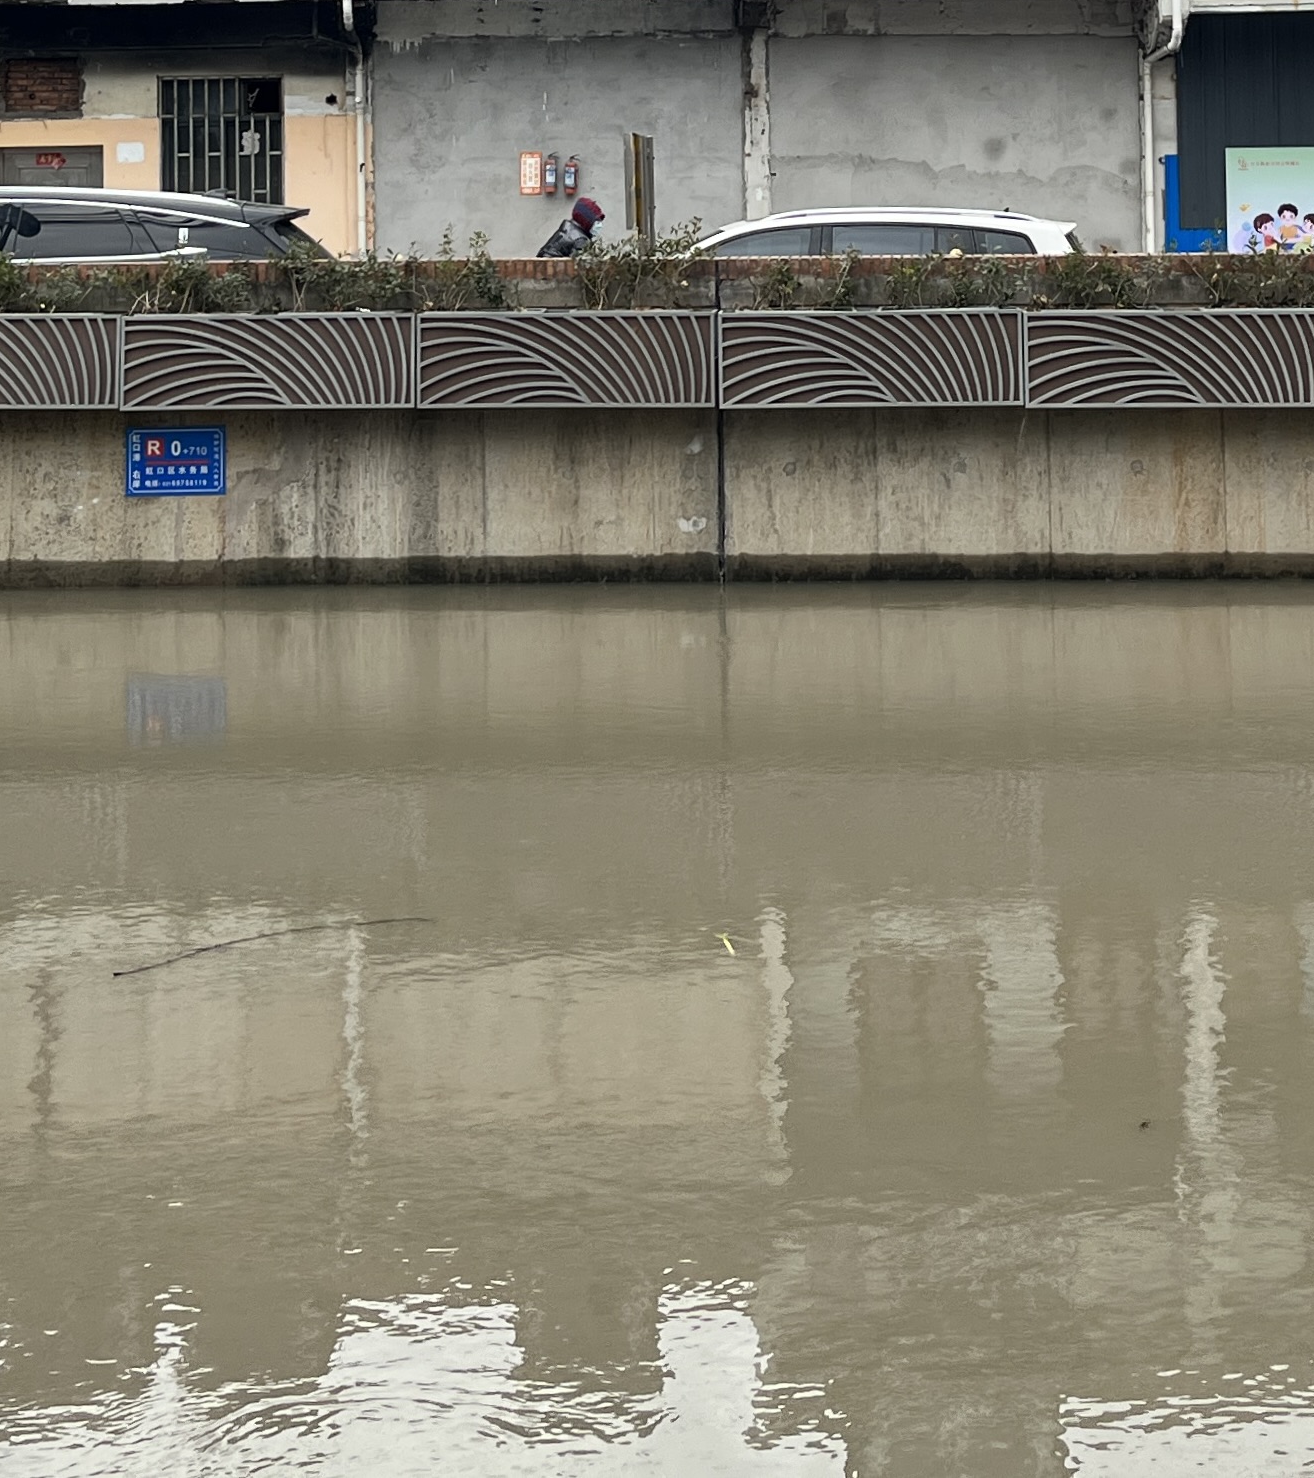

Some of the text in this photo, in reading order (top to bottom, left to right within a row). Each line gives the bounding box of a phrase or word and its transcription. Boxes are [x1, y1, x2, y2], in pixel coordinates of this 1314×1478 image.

[147, 440, 161, 456] R
[145, 465, 209, 475] 虹口区水务局
